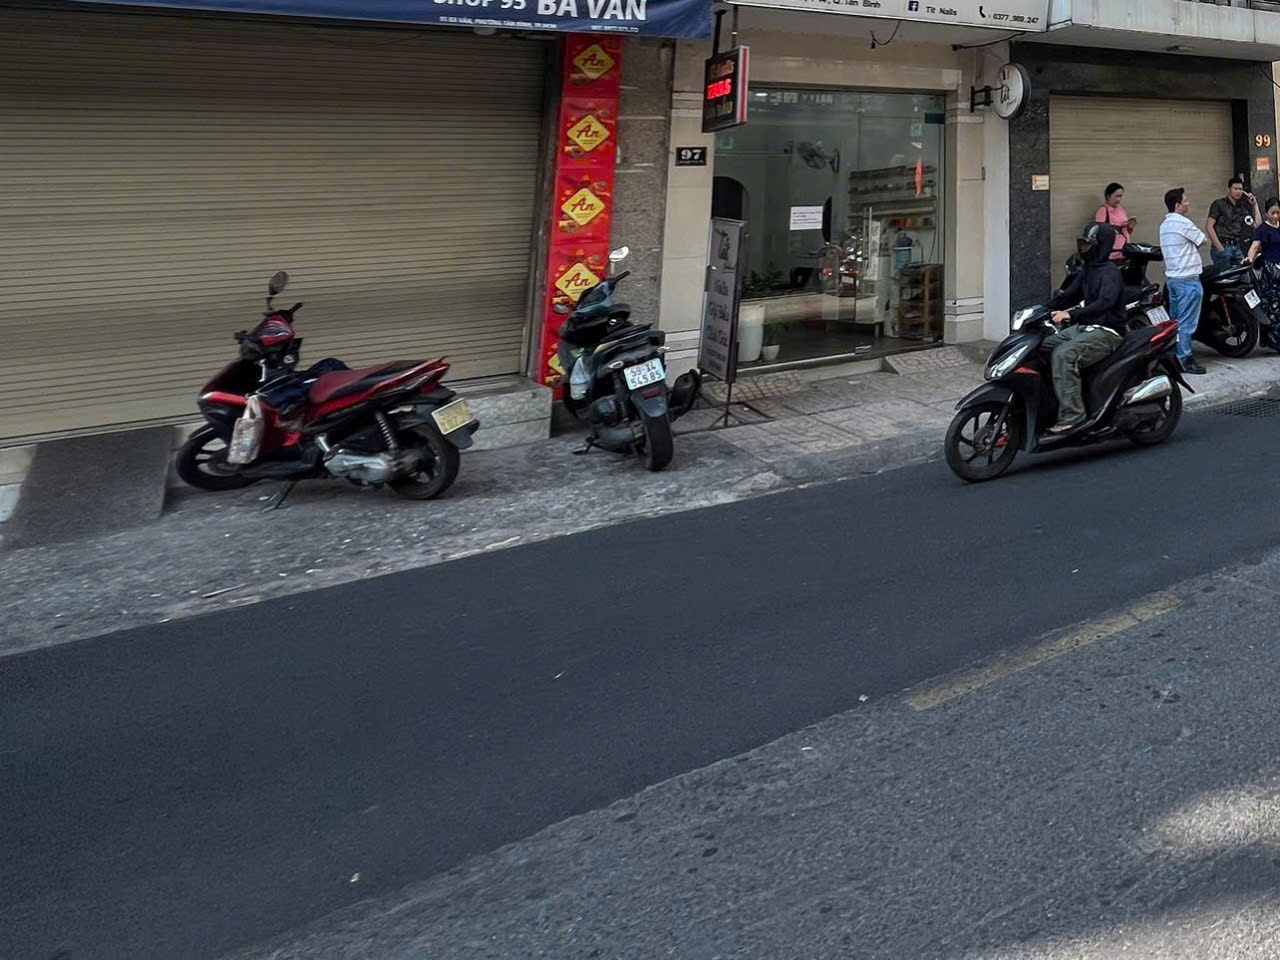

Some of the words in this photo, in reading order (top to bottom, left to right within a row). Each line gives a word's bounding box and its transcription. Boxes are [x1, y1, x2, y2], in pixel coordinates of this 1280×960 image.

[576, 124, 600, 139] An
[1256, 134, 1271, 148] 99
[681, 149, 702, 160] 97
[571, 197, 596, 213] An
[565, 272, 591, 288] An
